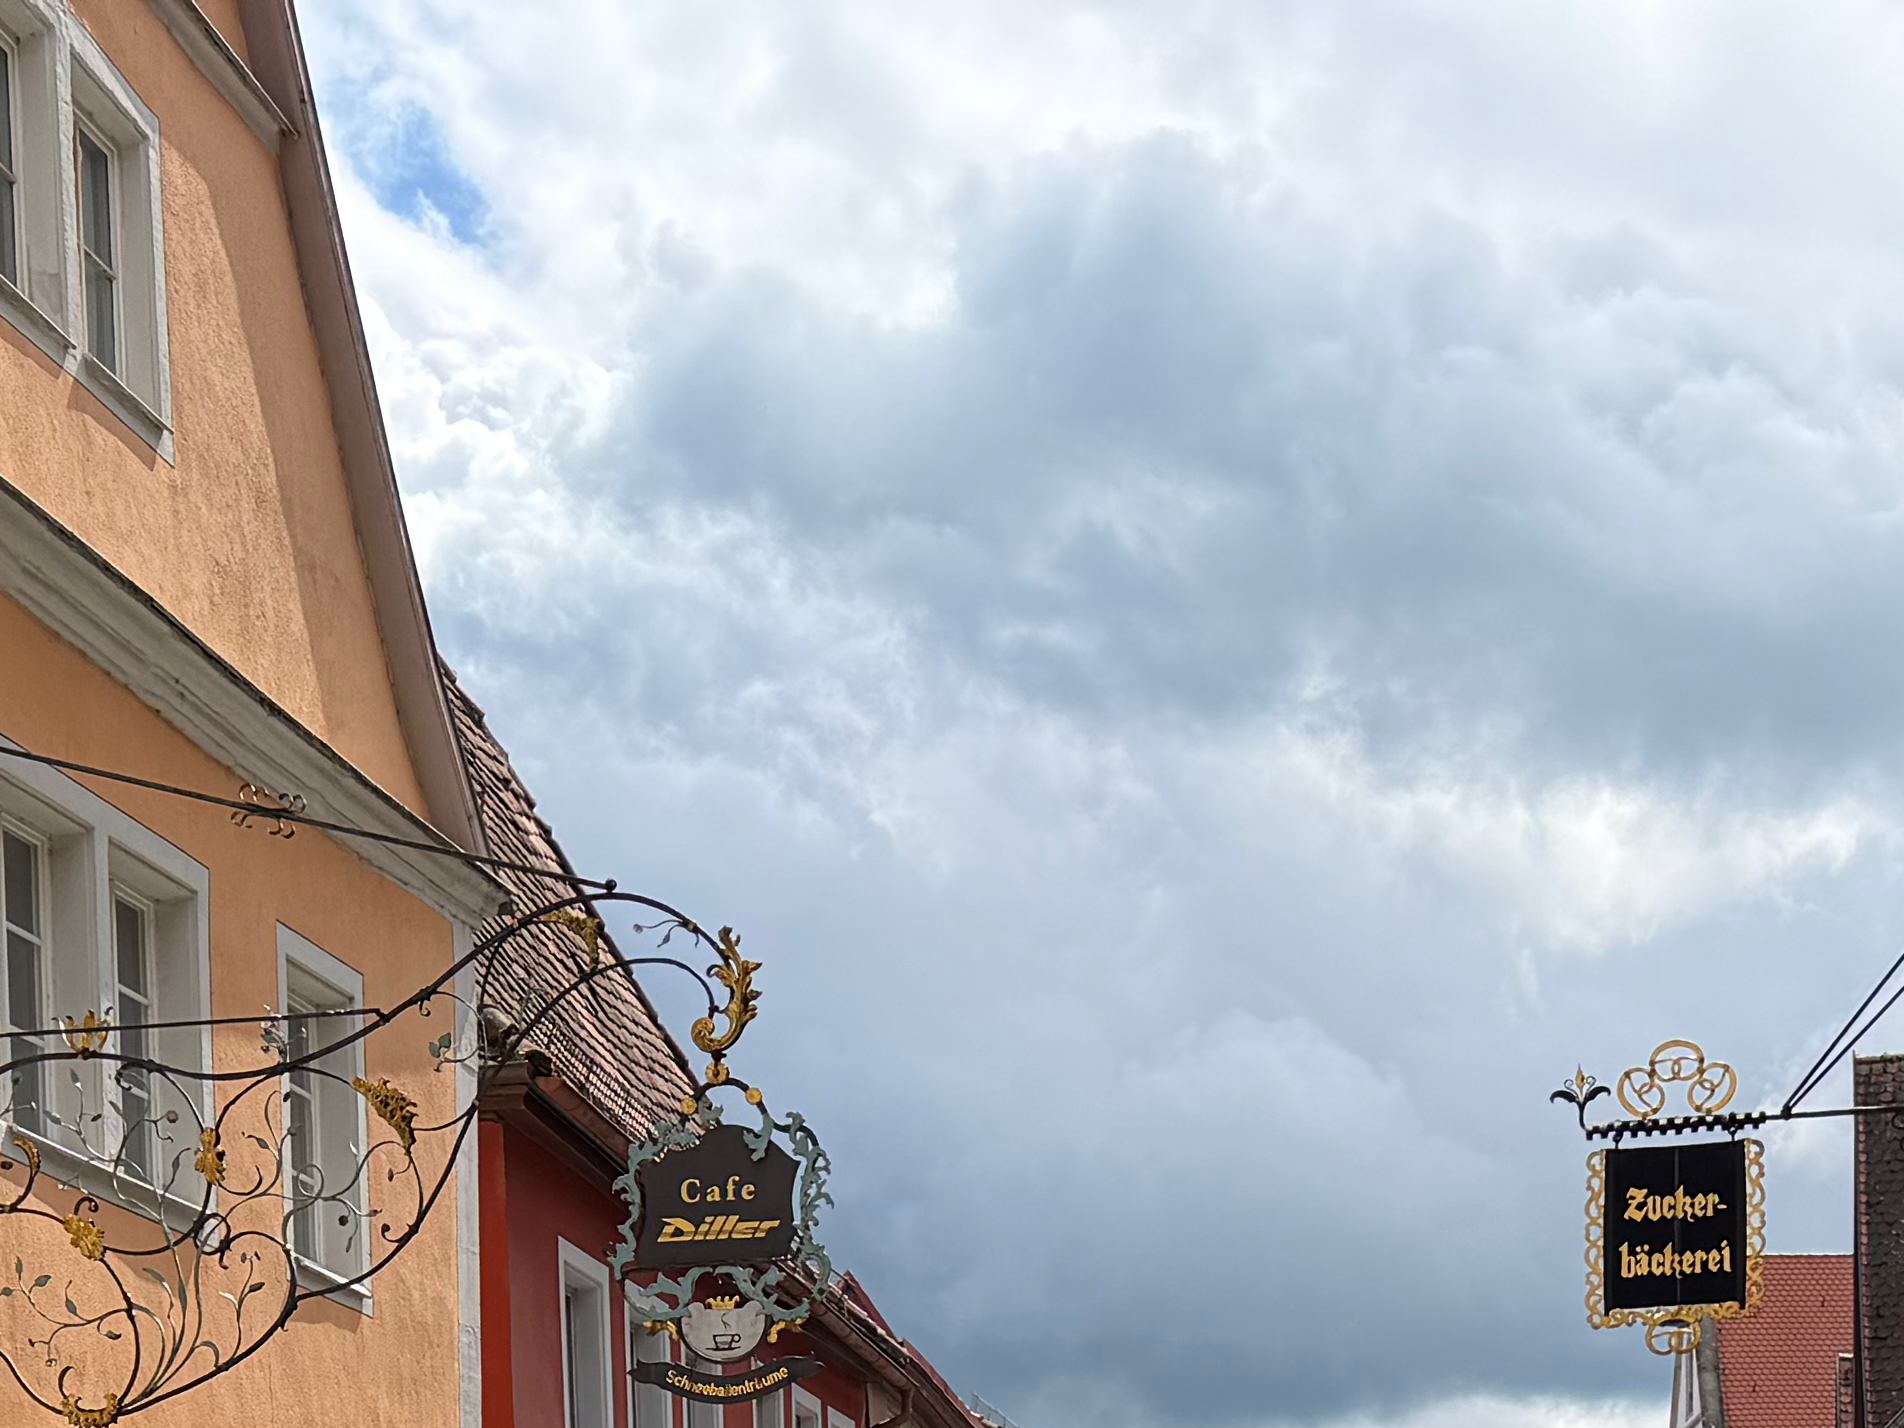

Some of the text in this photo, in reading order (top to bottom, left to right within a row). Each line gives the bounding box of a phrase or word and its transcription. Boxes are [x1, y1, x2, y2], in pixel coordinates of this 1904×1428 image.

[680, 1175, 757, 1204] Cafe
[1623, 1184, 1728, 1223] Zucker-
[657, 1215, 782, 1243] Diller
[1618, 1239, 1732, 1280] bäckerei
